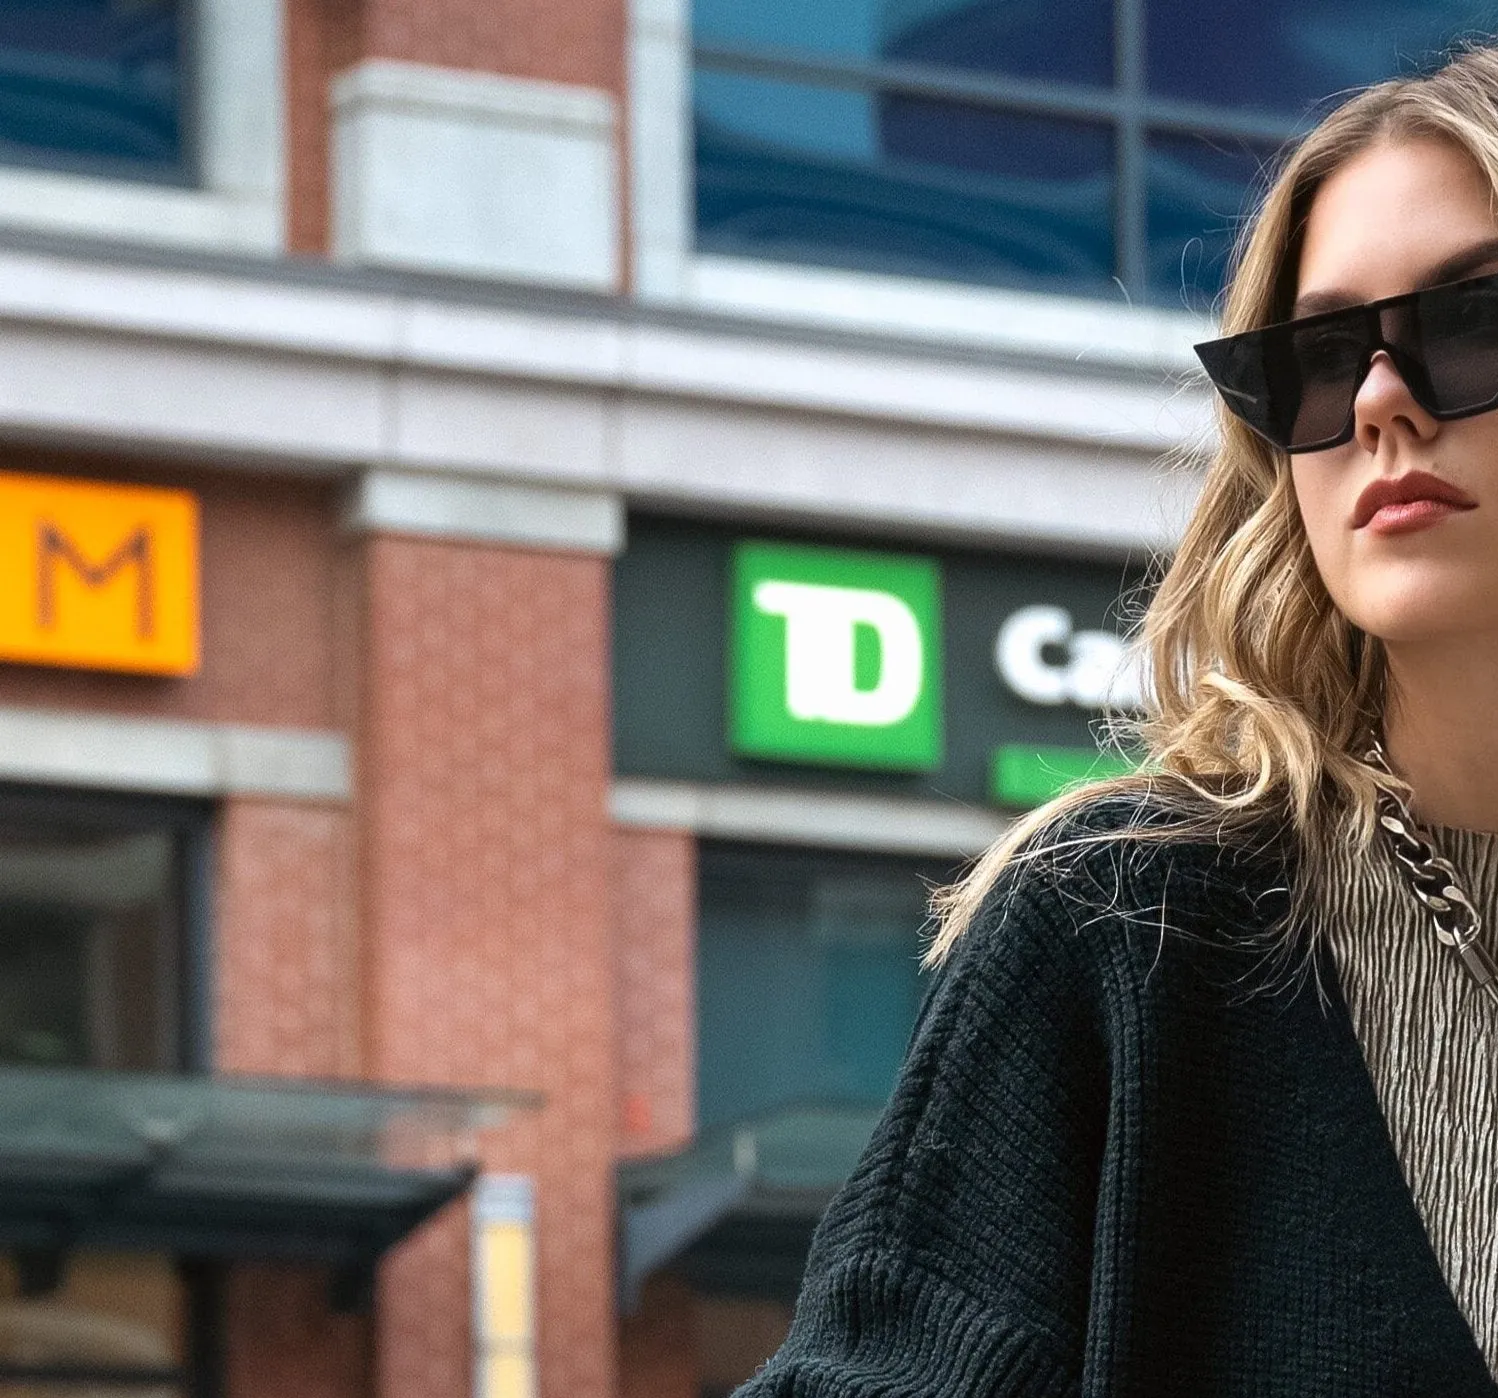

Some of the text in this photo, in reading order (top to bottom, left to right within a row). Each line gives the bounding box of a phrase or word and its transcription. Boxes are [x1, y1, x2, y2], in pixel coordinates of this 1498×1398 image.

[36, 520, 154, 642] M
[754, 580, 1160, 726] TD Ca
